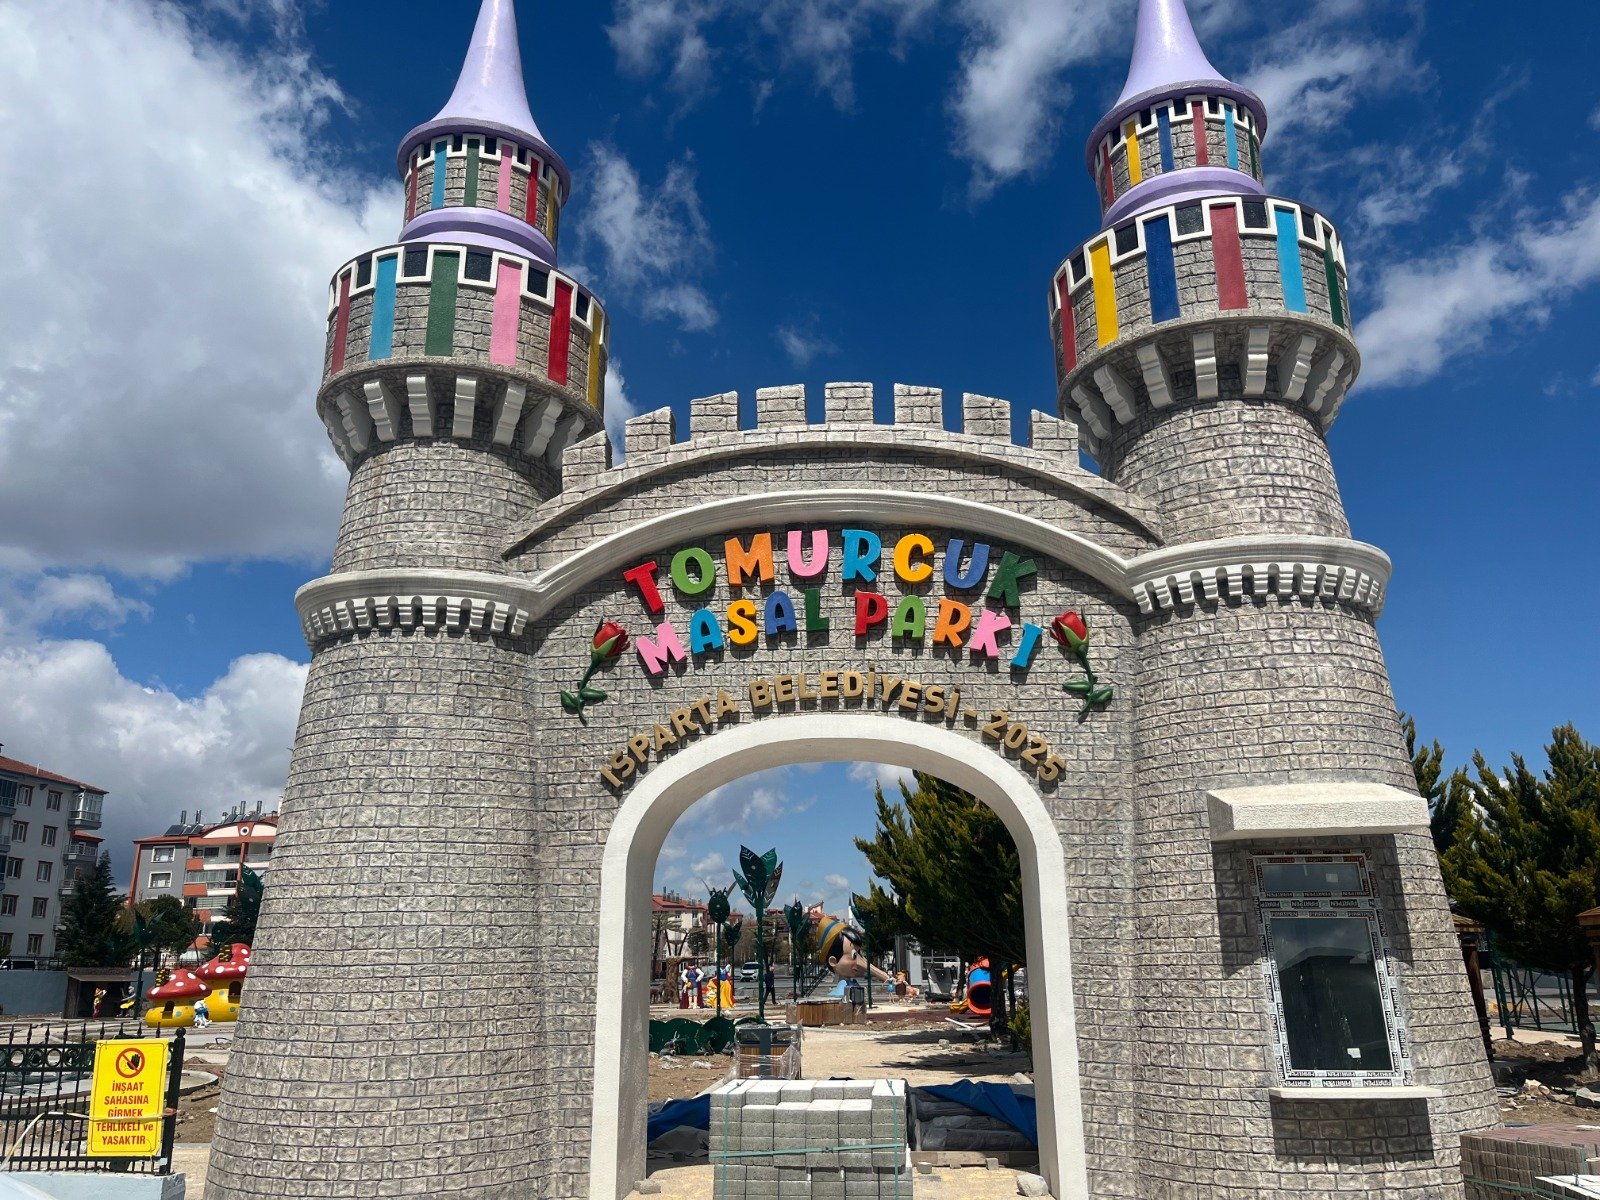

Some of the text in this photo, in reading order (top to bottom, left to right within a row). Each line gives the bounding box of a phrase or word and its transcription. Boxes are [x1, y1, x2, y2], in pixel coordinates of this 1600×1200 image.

[623, 529, 1038, 614] TOMURCUK
[636, 587, 1044, 675] MASAL PARKI
[600, 687, 739, 788] ISPARTA
[749, 664, 960, 719] BELEDİYESİ
[982, 709, 1066, 782] 2025
[111, 1080, 144, 1094] İNŞAAT
[104, 1095, 149, 1105] SAHASINA
[107, 1107, 143, 1118] GİRMEK
[96, 1120, 154, 1132] TEHLİKELİ ve
[102, 1135, 146, 1145] YASAKTIR
